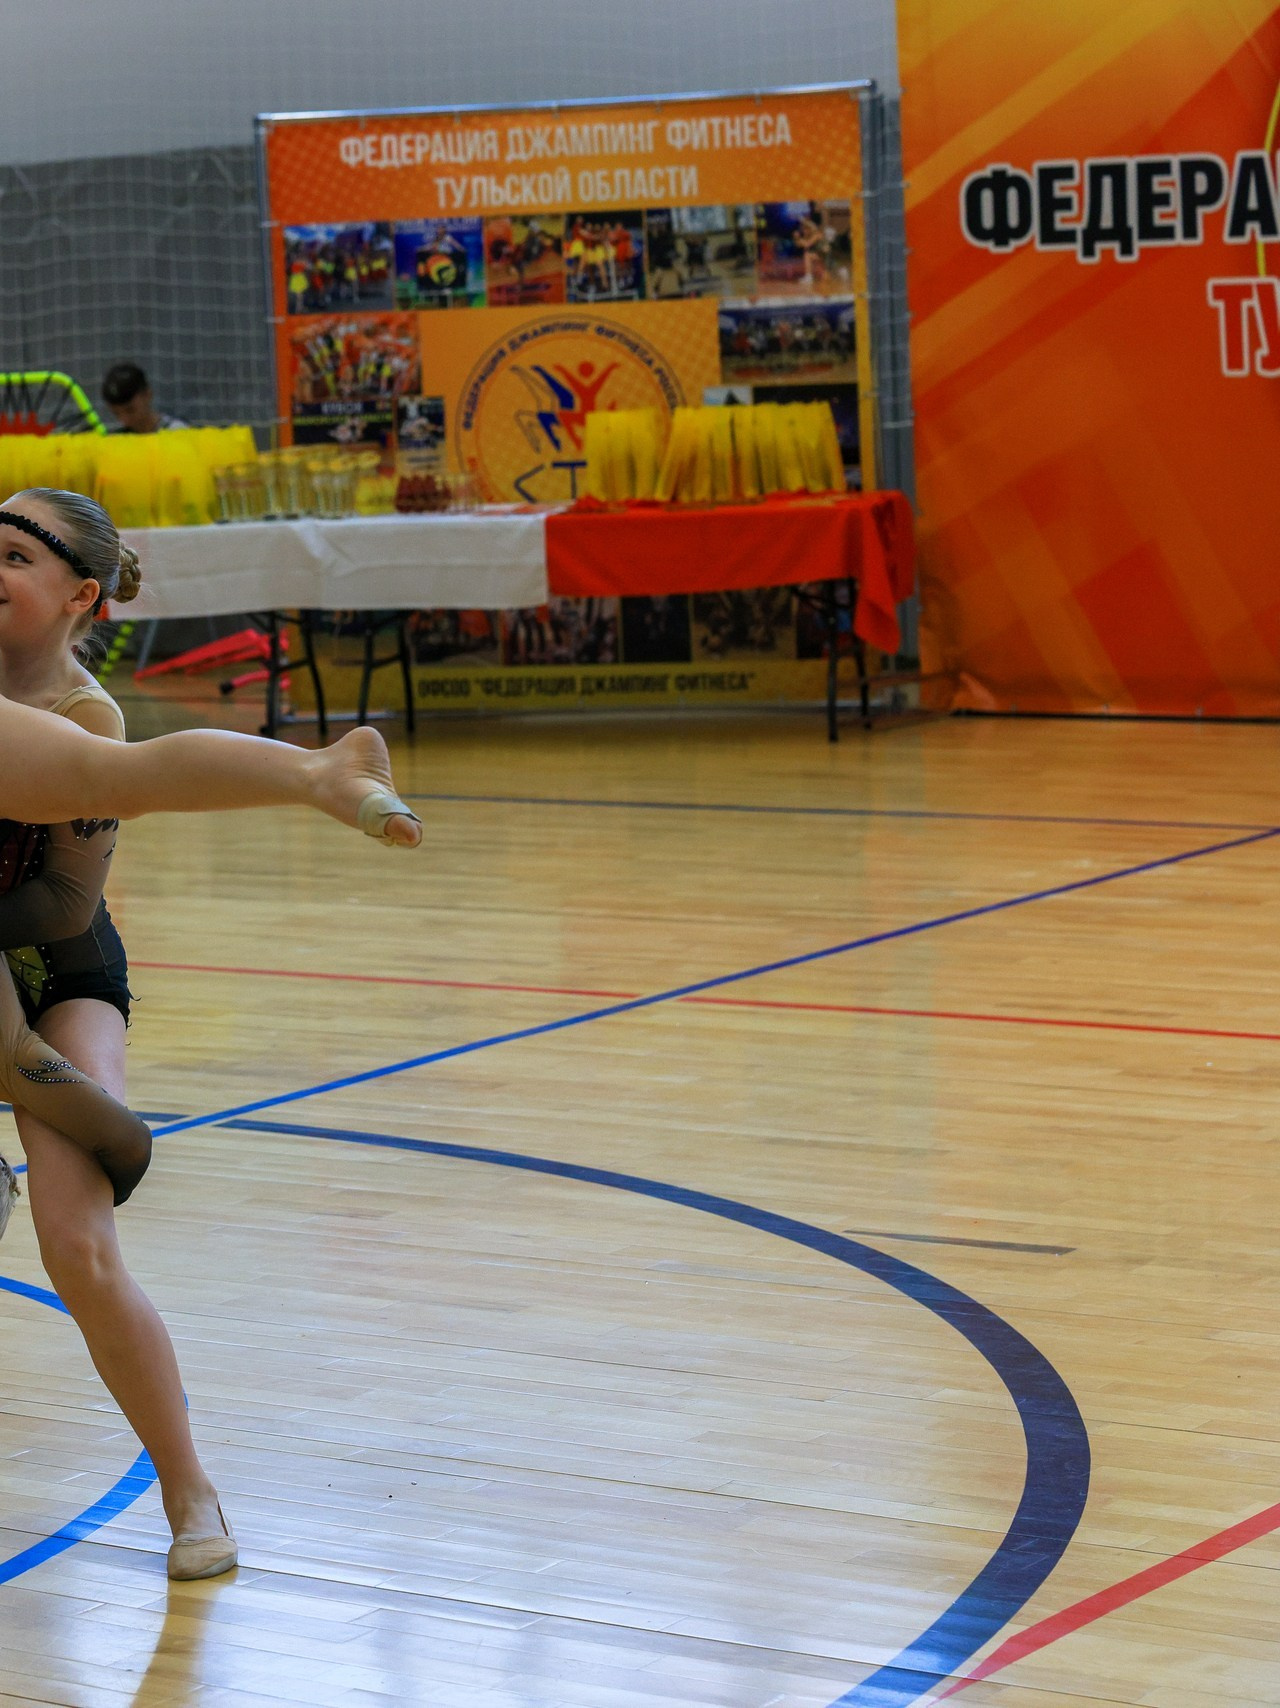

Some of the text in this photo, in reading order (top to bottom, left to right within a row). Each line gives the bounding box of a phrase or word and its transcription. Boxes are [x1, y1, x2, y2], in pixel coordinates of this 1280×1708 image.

[339, 112, 793, 169] ФЕДЕРАЦИЯ ДЖАМПИНГ ФИТНЕСА
[434, 165, 700, 208] ТУЛЬСКОЙ ОБЛАСТИ
[960, 149, 1280, 263] ФЕДЕРА
